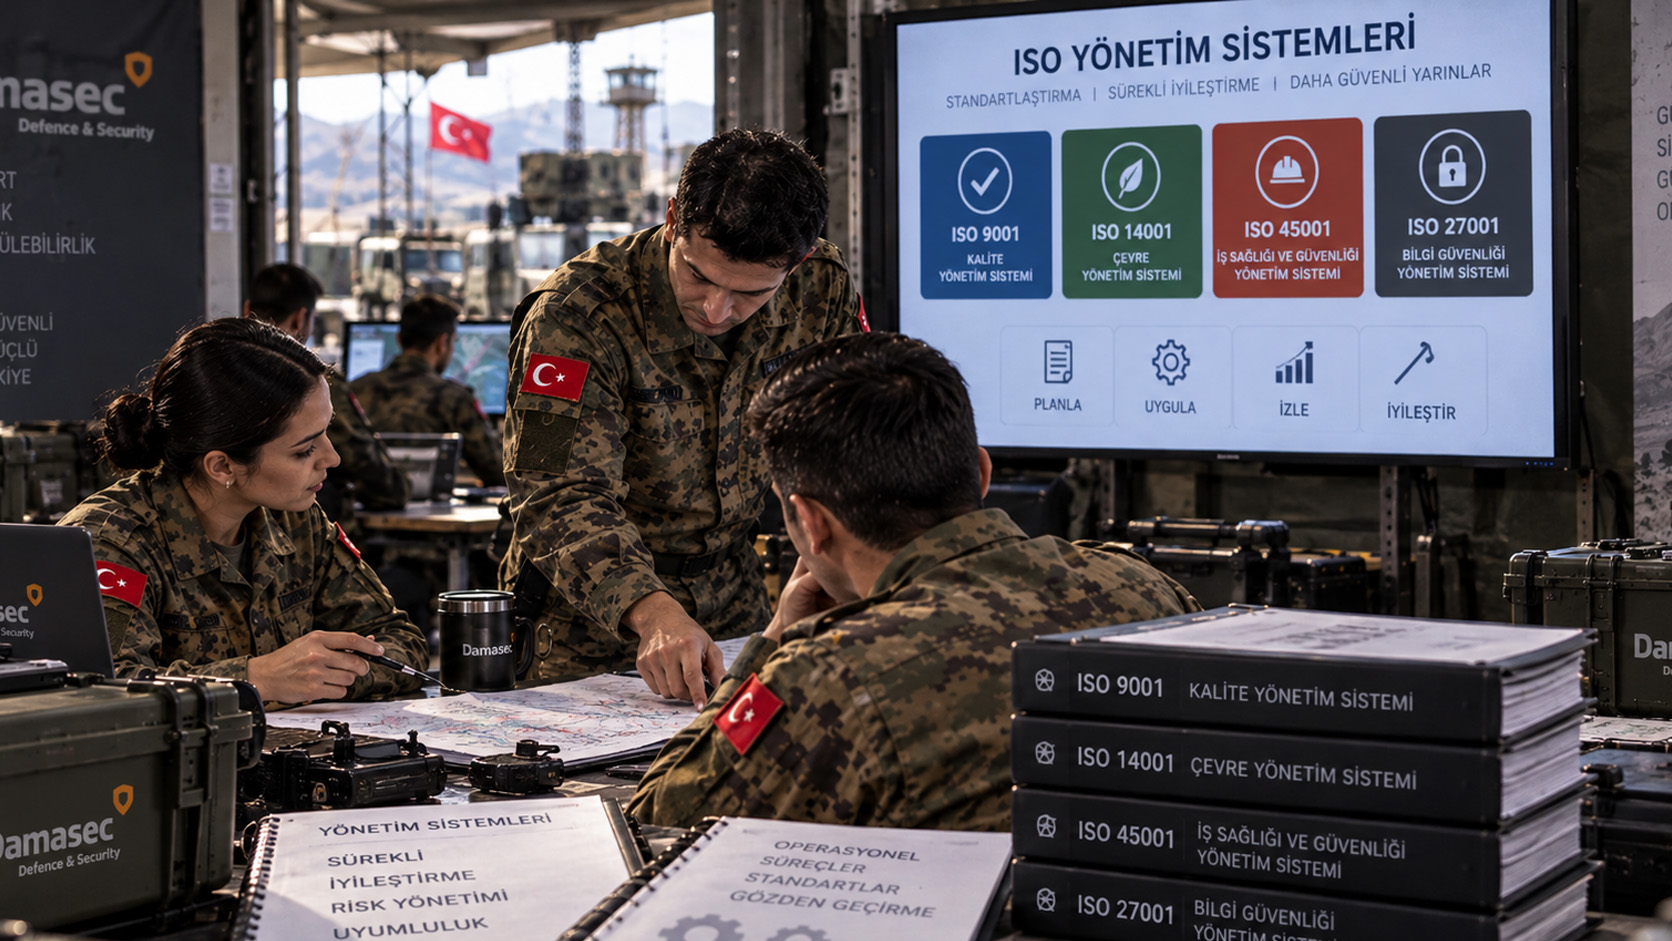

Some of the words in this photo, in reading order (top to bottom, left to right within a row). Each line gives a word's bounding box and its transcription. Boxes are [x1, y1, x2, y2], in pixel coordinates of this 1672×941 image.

[1014, 46, 1062, 76] ISO
[1071, 30, 1211, 72] YÖNETİM
[1222, 12, 1415, 62] SİSTEMLERİ
[946, 88, 1082, 109] STANDARTLAŞTIRMA
[1108, 80, 1166, 100] SÜREKLİ
[1171, 75, 1260, 97] İYİLEŞTİRME
[1290, 73, 1333, 90] DAHA
[1338, 65, 1407, 87] GÜVENLİ
[1412, 63, 1492, 82] YARINLAR
[1657, 105, 1672, 125] G
[18, 118, 79, 135] Defence
[82, 121, 94, 136] &
[97, 122, 155, 142] Security
[1657, 169, 1672, 189] G
[1657, 202, 1672, 221] O
[952, 227, 978, 242] ISO
[982, 226, 1019, 242] 9001
[1092, 224, 1119, 240] ISO
[1125, 223, 1171, 240] 14001
[1245, 221, 1274, 237] ISO
[1279, 220, 1330, 237] 45001
[1408, 218, 1439, 235] ISO
[1445, 217, 1499, 235] 27001
[0, 231, 96, 254] ÜLEBİLİRLİK
[967, 251, 1004, 265] KALİTE
[1113, 252, 1149, 266] ÇEVRE
[1217, 250, 1227, 265] İŞ
[1230, 249, 1275, 262] SAĞLIĞI
[1278, 251, 1293, 262] VE
[1296, 248, 1359, 262] GÜVENLİĞİ
[1402, 246, 1434, 261] BİLGİ
[1438, 245, 1505, 261] GÜVENLİĞİ
[939, 268, 987, 282] YÖNETİM
[990, 268, 1033, 282] SİSTEMİ
[1082, 267, 1133, 281] YÖNETİM
[1136, 267, 1182, 281] SİSTEMİ
[1235, 266, 1289, 280] YÖNETİM
[1292, 266, 1341, 280] SİSTEMİ
[1397, 265, 1454, 279] YÖNETİM
[1458, 264, 1509, 279] SİSTEMİ
[1034, 397, 1083, 412] PLANLA
[1144, 400, 1197, 414] UYGULA
[1279, 400, 1309, 417] İZLE
[1387, 402, 1456, 423] İYİLEŞTİR
[1634, 633, 1672, 660] Da
[1077, 672, 1110, 694] ISO
[1117, 675, 1162, 697] 9001
[1190, 681, 1249, 701] KALİTE
[1254, 684, 1335, 707] YÖNETİM
[1341, 688, 1413, 712] SİSTEMİ
[1077, 746, 1110, 768] ISO
[1117, 750, 1174, 773] 14001
[1190, 757, 1248, 777] ÇEVRE
[1254, 759, 1336, 784] YÖNETİM
[1342, 765, 1417, 790] SİSTEMİ
[319, 820, 420, 837] YÖNETİM
[427, 812, 552, 831] SİSTEMLERİ
[0, 818, 114, 860] amasec
[1078, 820, 1111, 842] ISO
[1117, 824, 1174, 849] 45001
[1197, 821, 1212, 844] İŞ
[1217, 824, 1282, 847] SAĞLIĞI
[1287, 832, 1308, 850] VE
[1313, 833, 1405, 860] GÜVENLİĞİ
[328, 849, 424, 867] SÜREKLİ
[774, 840, 921, 862] OPERASYONEL
[18, 861, 64, 877] Defence
[66, 855, 75, 867] &
[77, 847, 121, 865] Security
[760, 855, 867, 874] SÜREÇLER
[1197, 847, 1271, 871] YÖNETİM
[1276, 854, 1342, 879] SİSTEMİ
[330, 870, 477, 889] İYİLEŞTİRME
[745, 872, 901, 895] STANDARTLAR
[331, 898, 386, 914] RİSK
[393, 888, 509, 910] YÖNETİMİ
[730, 889, 827, 909] GÖZDEN
[832, 899, 937, 918] GEÇİRME
[1077, 894, 1110, 917] ISO
[1116, 899, 1173, 925] 27001
[1194, 898, 1237, 919] BİLGİ
[1242, 903, 1335, 931] GÜVENLİĞİ
[333, 916, 489, 941] UYUMLULUK
